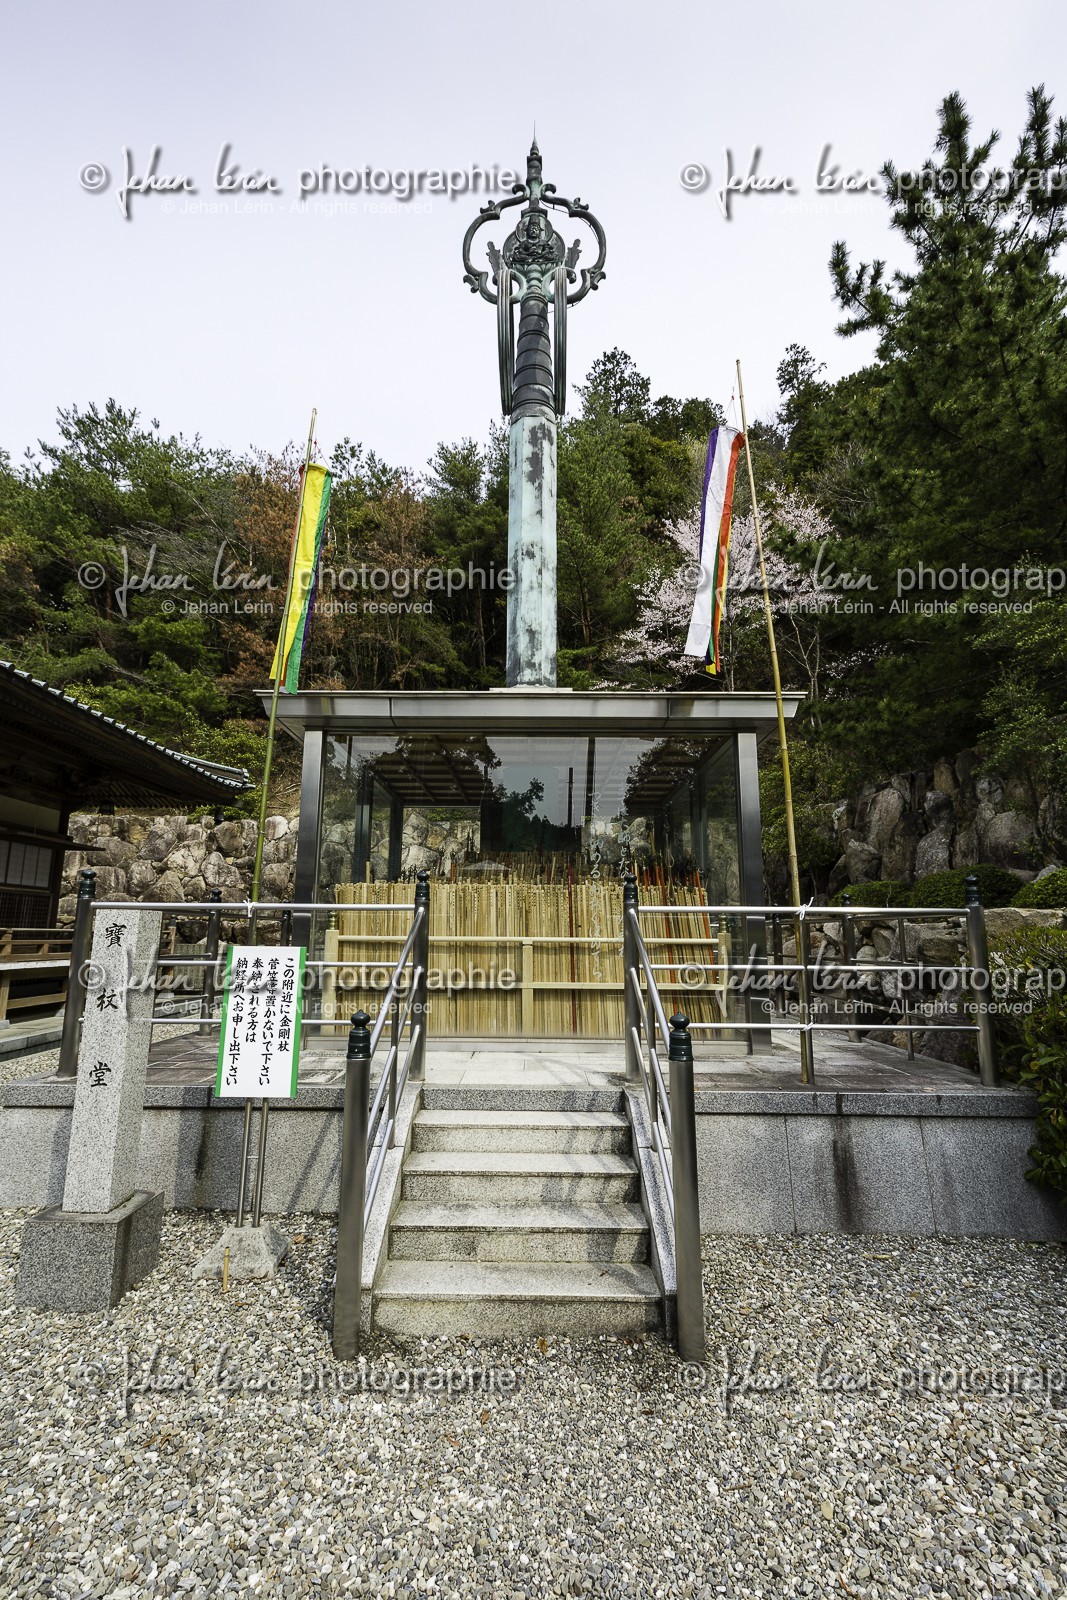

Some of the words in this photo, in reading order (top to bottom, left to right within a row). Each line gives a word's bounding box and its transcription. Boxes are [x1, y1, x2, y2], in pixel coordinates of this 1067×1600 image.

[226, 957, 248, 1086] 納経所へお申し出下さい
[245, 957, 264, 1043] 奉納される方は
[259, 958, 280, 1086] 菅笠等置かないで下さい
[277, 958, 295, 1052] この附近に金剛杖
